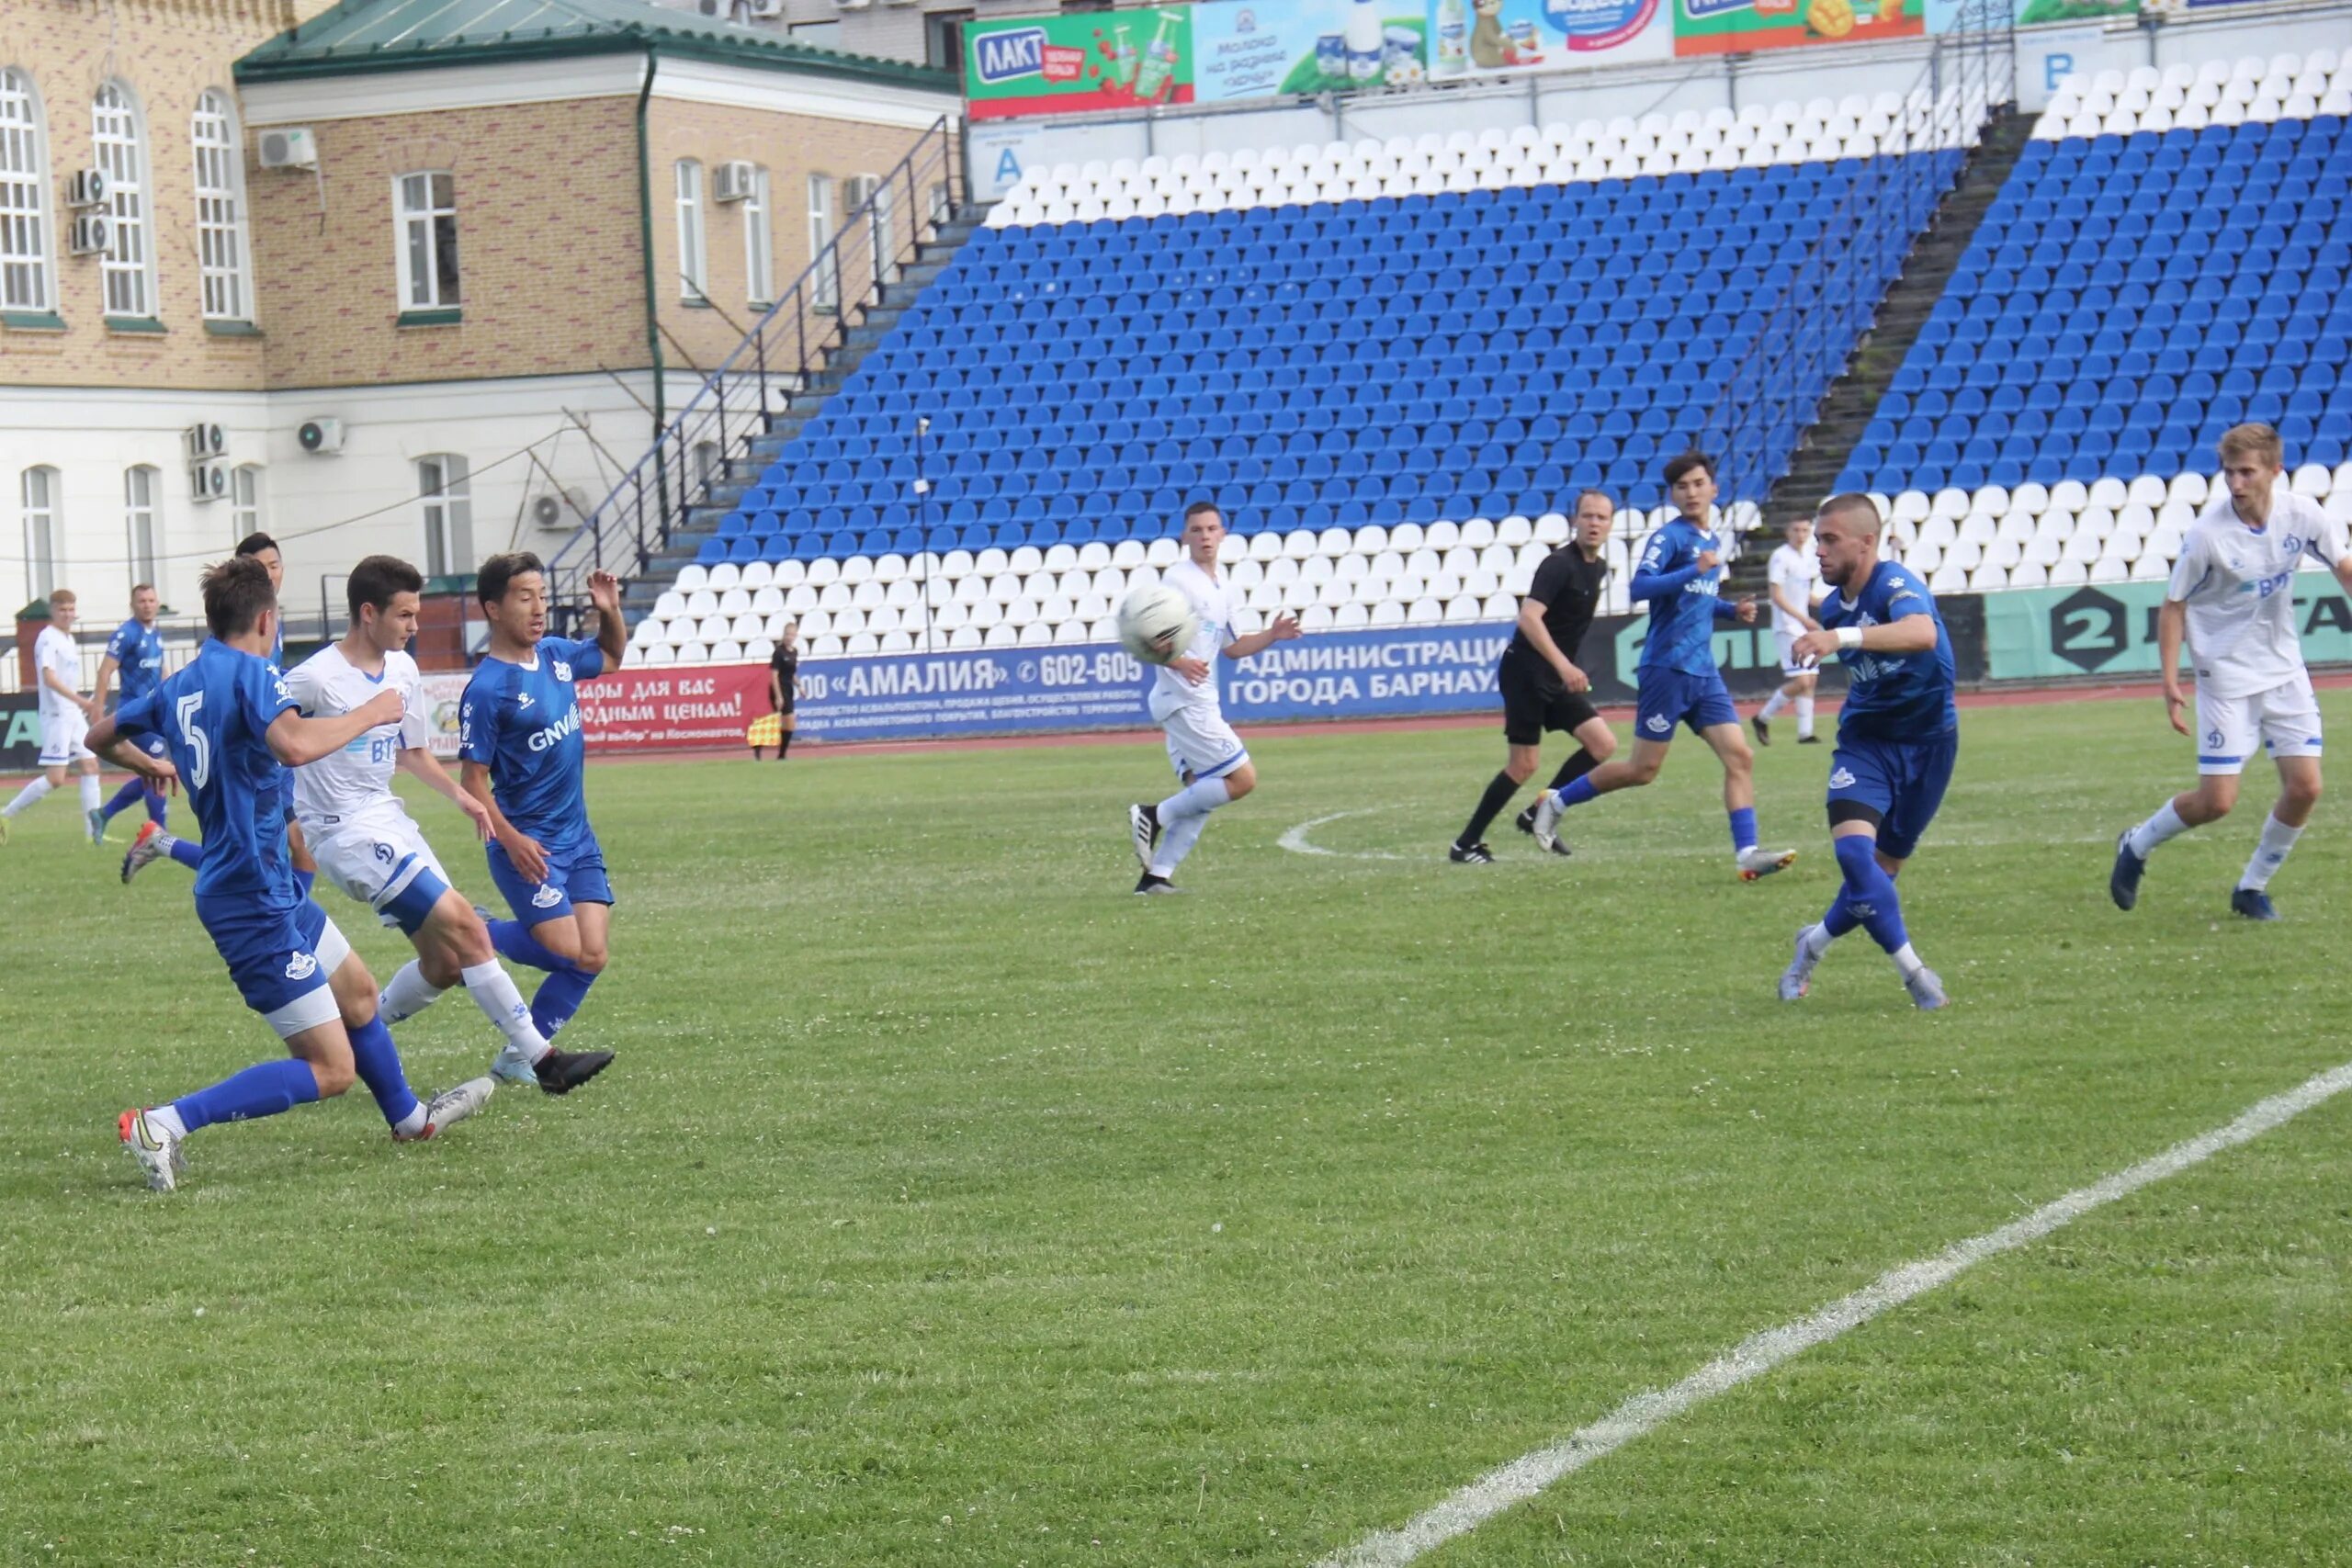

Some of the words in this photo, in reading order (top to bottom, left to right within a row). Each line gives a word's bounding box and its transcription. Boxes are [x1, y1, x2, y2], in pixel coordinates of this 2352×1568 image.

[2063, 607, 2115, 650] 2
[1040, 651, 1142, 685] 602-605
[1236, 637, 1509, 677] АДМИНИСТРАЦИ
[1229, 676, 1360, 705] ГОРОДА
[1370, 668, 1499, 698] БАРНАУ
[176, 690, 209, 789] 5
